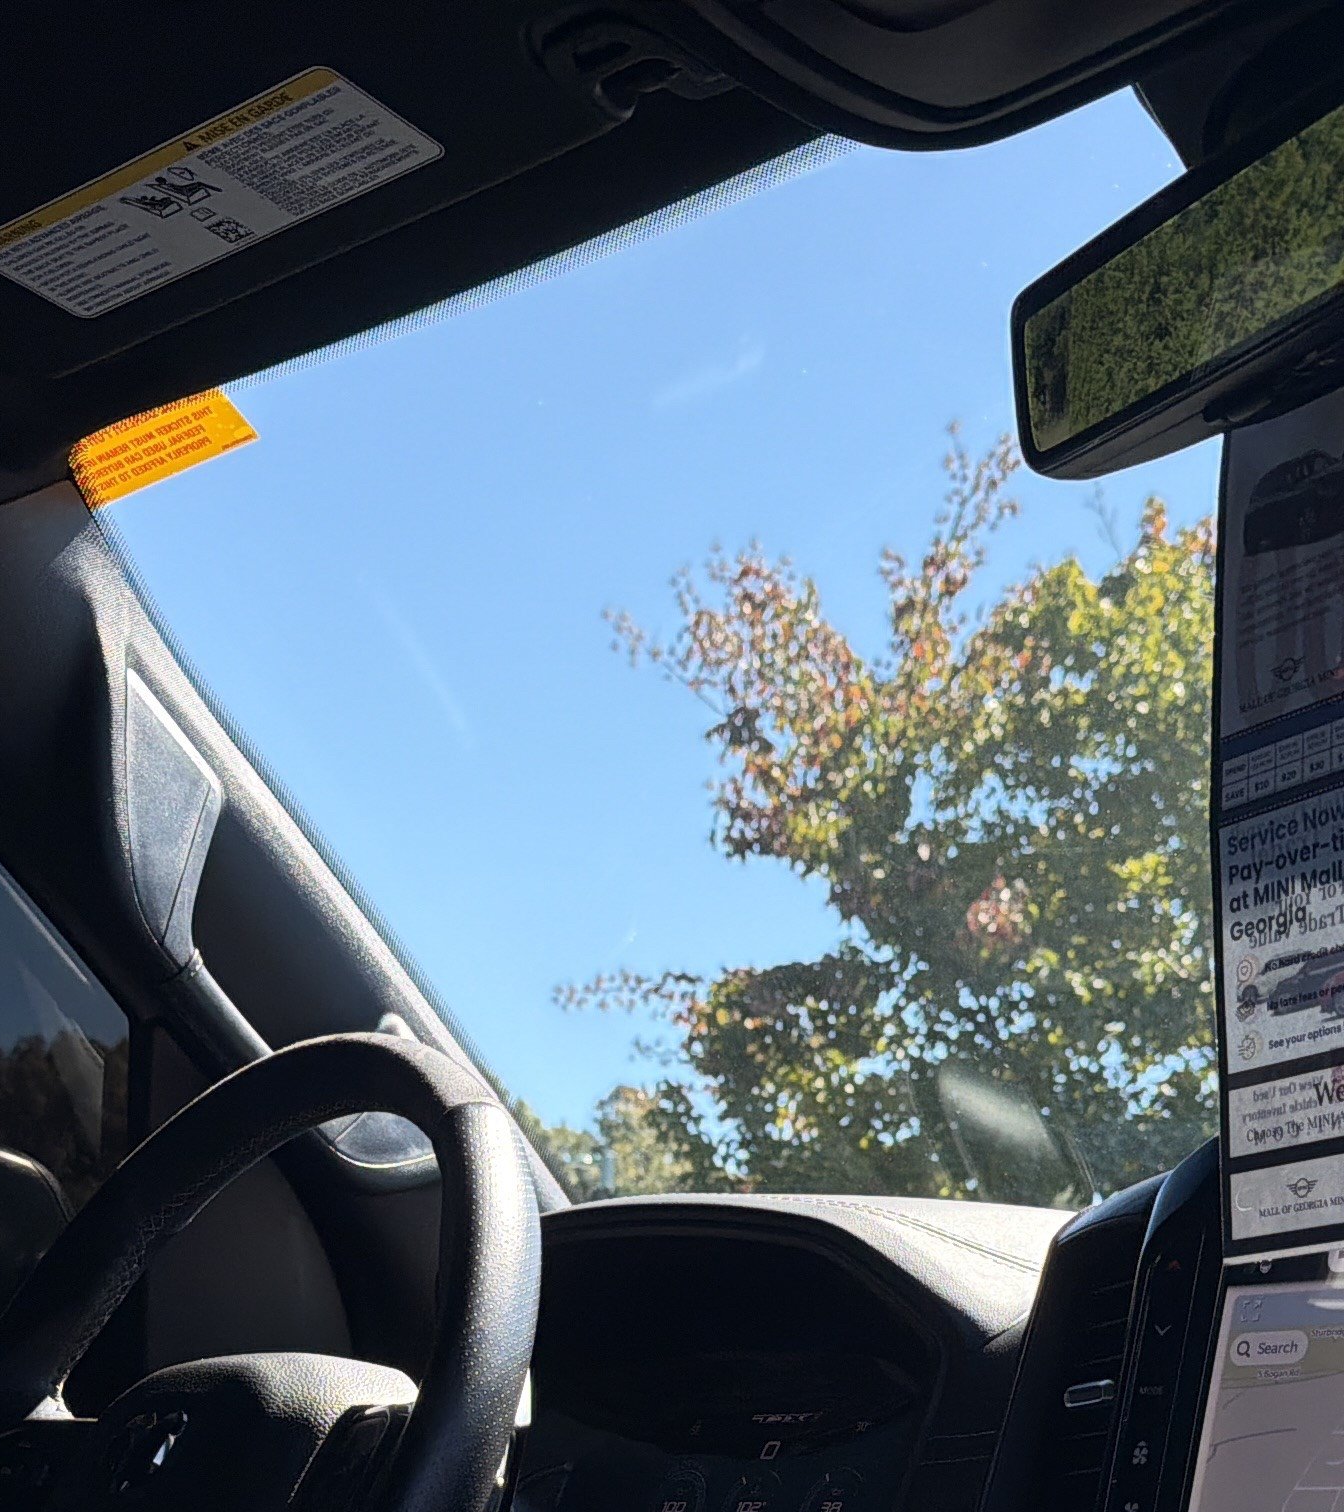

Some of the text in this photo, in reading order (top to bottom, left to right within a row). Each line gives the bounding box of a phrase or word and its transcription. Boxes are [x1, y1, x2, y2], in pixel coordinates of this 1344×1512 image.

[1228, 818, 1298, 856] Service
[1229, 893, 1248, 913] at
[1253, 878, 1295, 905] MINI
[1301, 861, 1343, 890] Mall
[1230, 905, 1307, 941] Georgia
[1268, 1036, 1284, 1049] See
[1286, 1032, 1306, 1047] your
[1307, 1022, 1341, 1041] options
[1259, 1206, 1279, 1218] MALL
[1281, 1204, 1292, 1214] OF
[1293, 1197, 1327, 1212] GEORGIA
[1257, 1340, 1298, 1356] Search
[759, 1440, 782, 1461] 0
